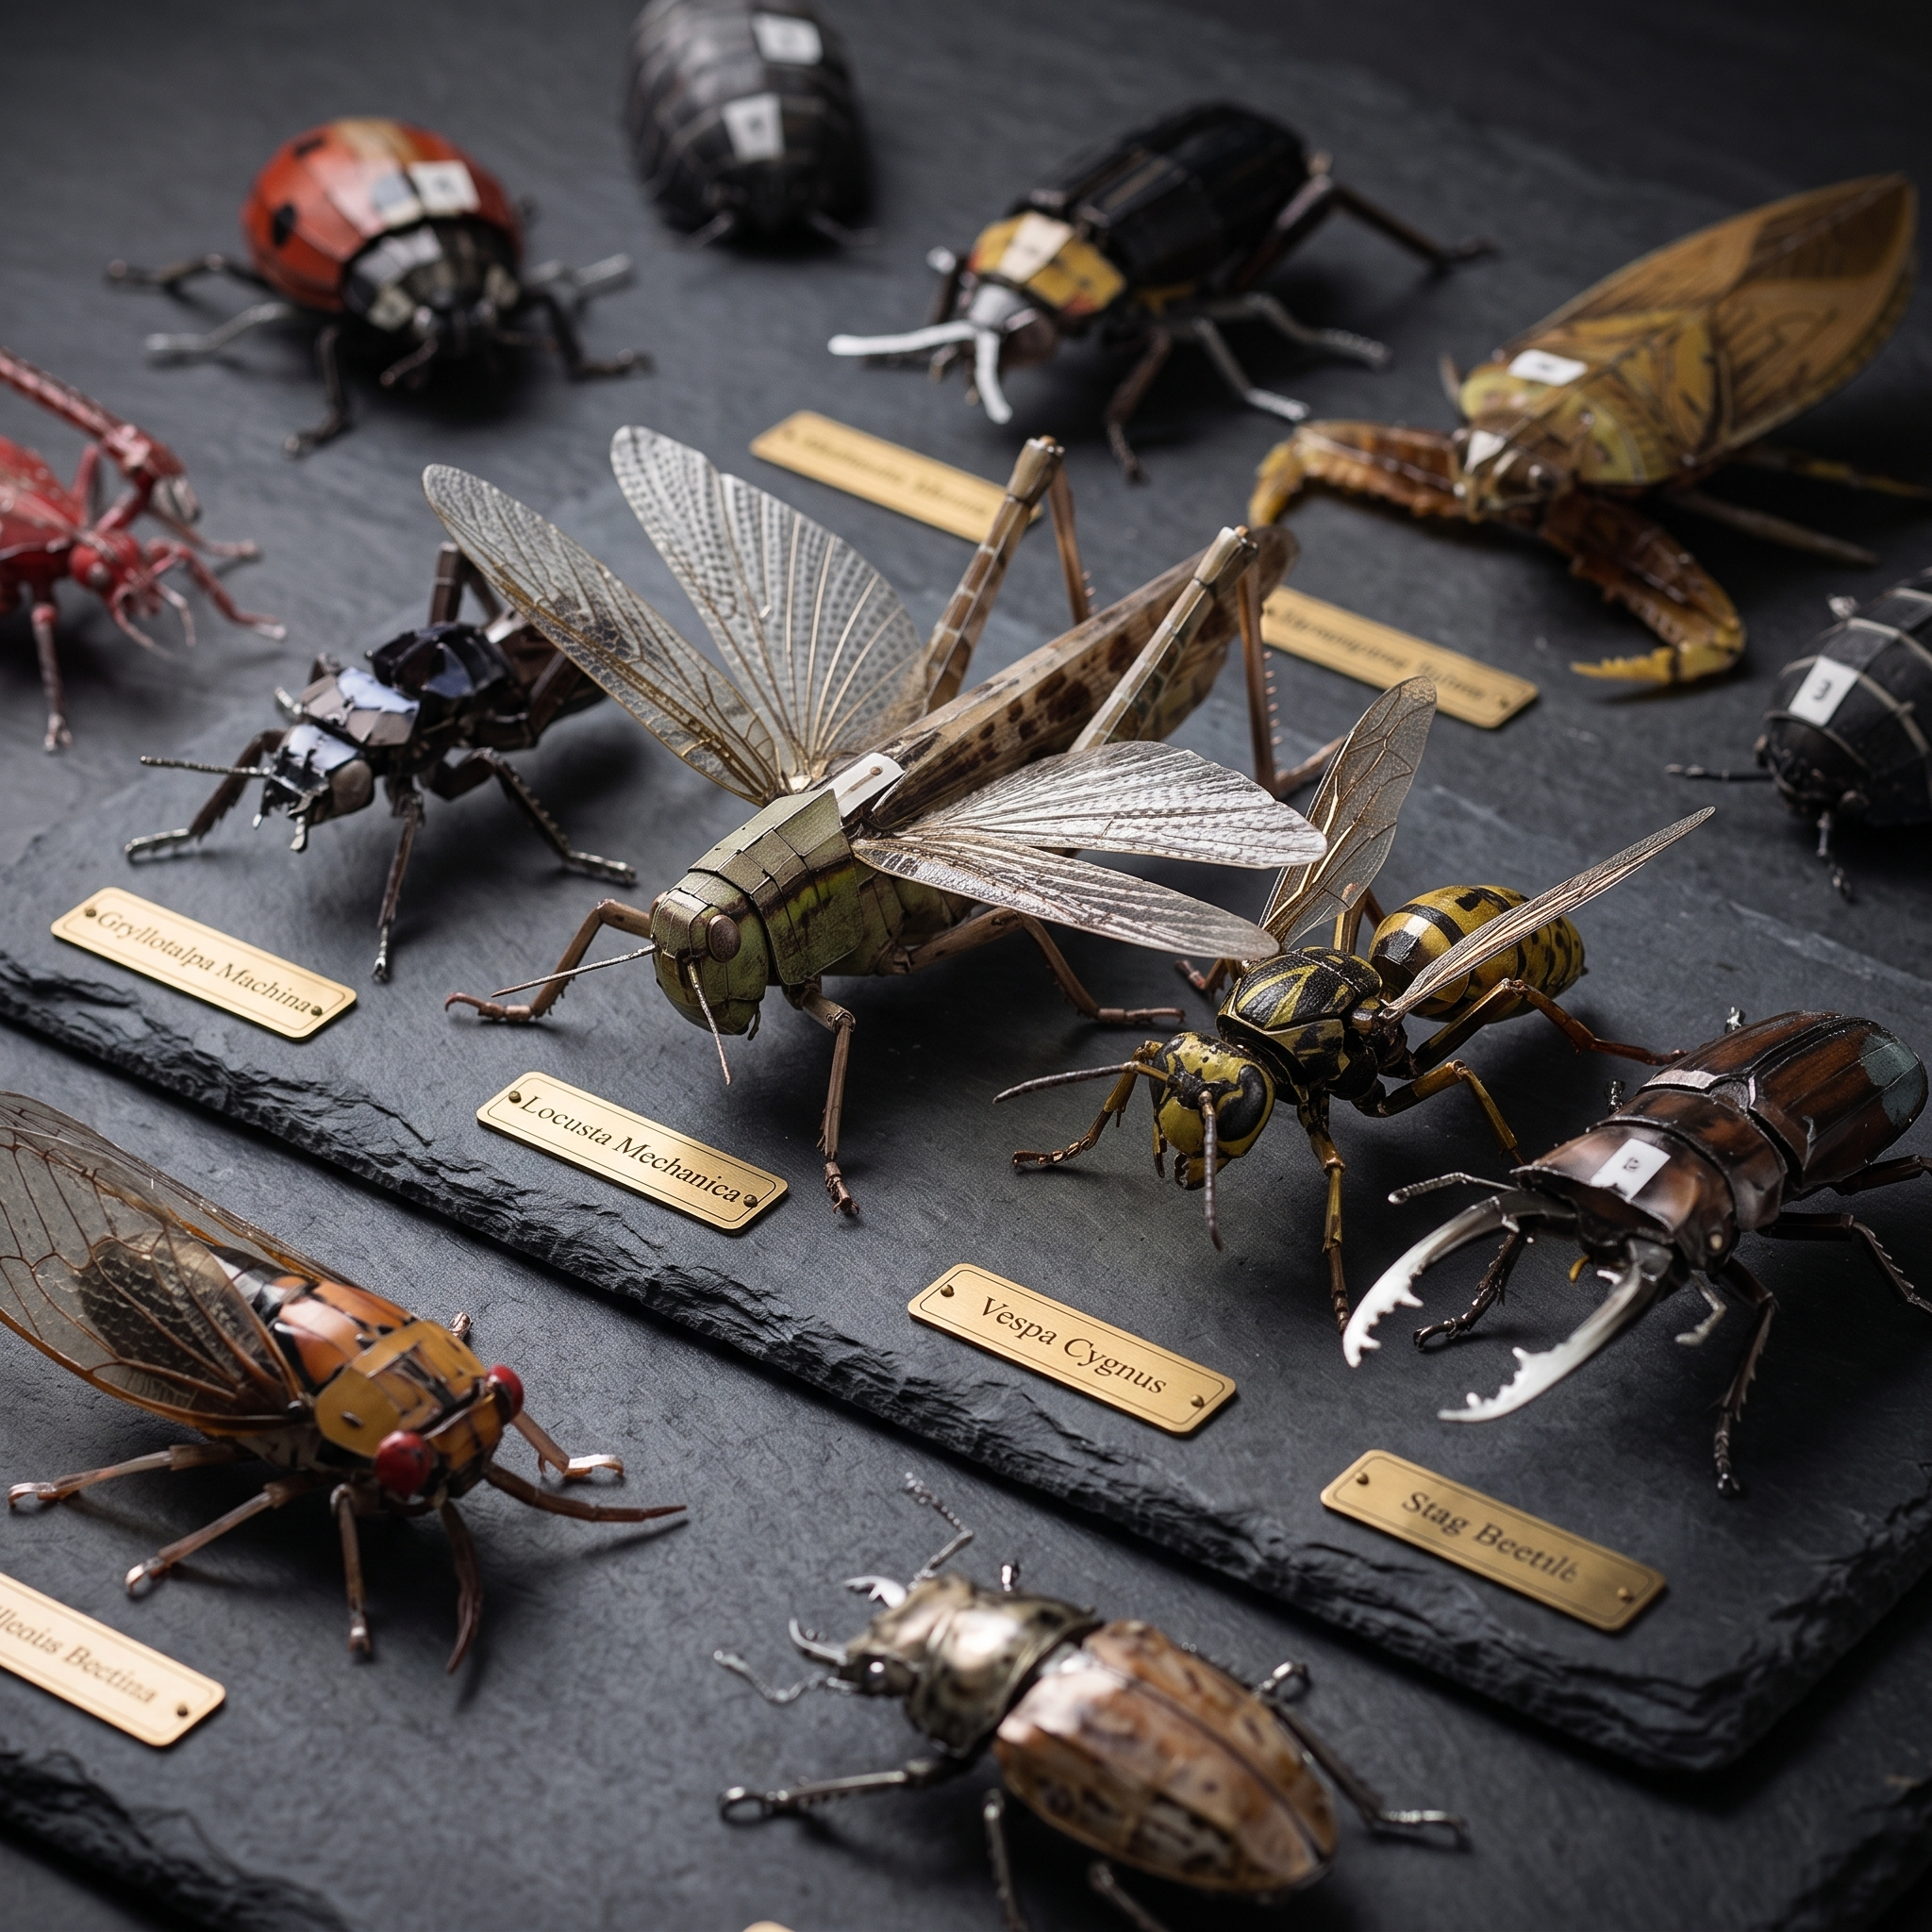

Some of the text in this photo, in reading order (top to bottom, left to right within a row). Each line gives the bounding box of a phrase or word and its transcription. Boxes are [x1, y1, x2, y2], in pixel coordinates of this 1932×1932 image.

[97, 910, 311, 1013] Gryllotalpa Machina
[519, 1095, 741, 1203] Locusta Mechanica
[980, 1295, 1168, 1395] Vespa Cygnus
[1401, 1491, 1471, 1539] Stag
